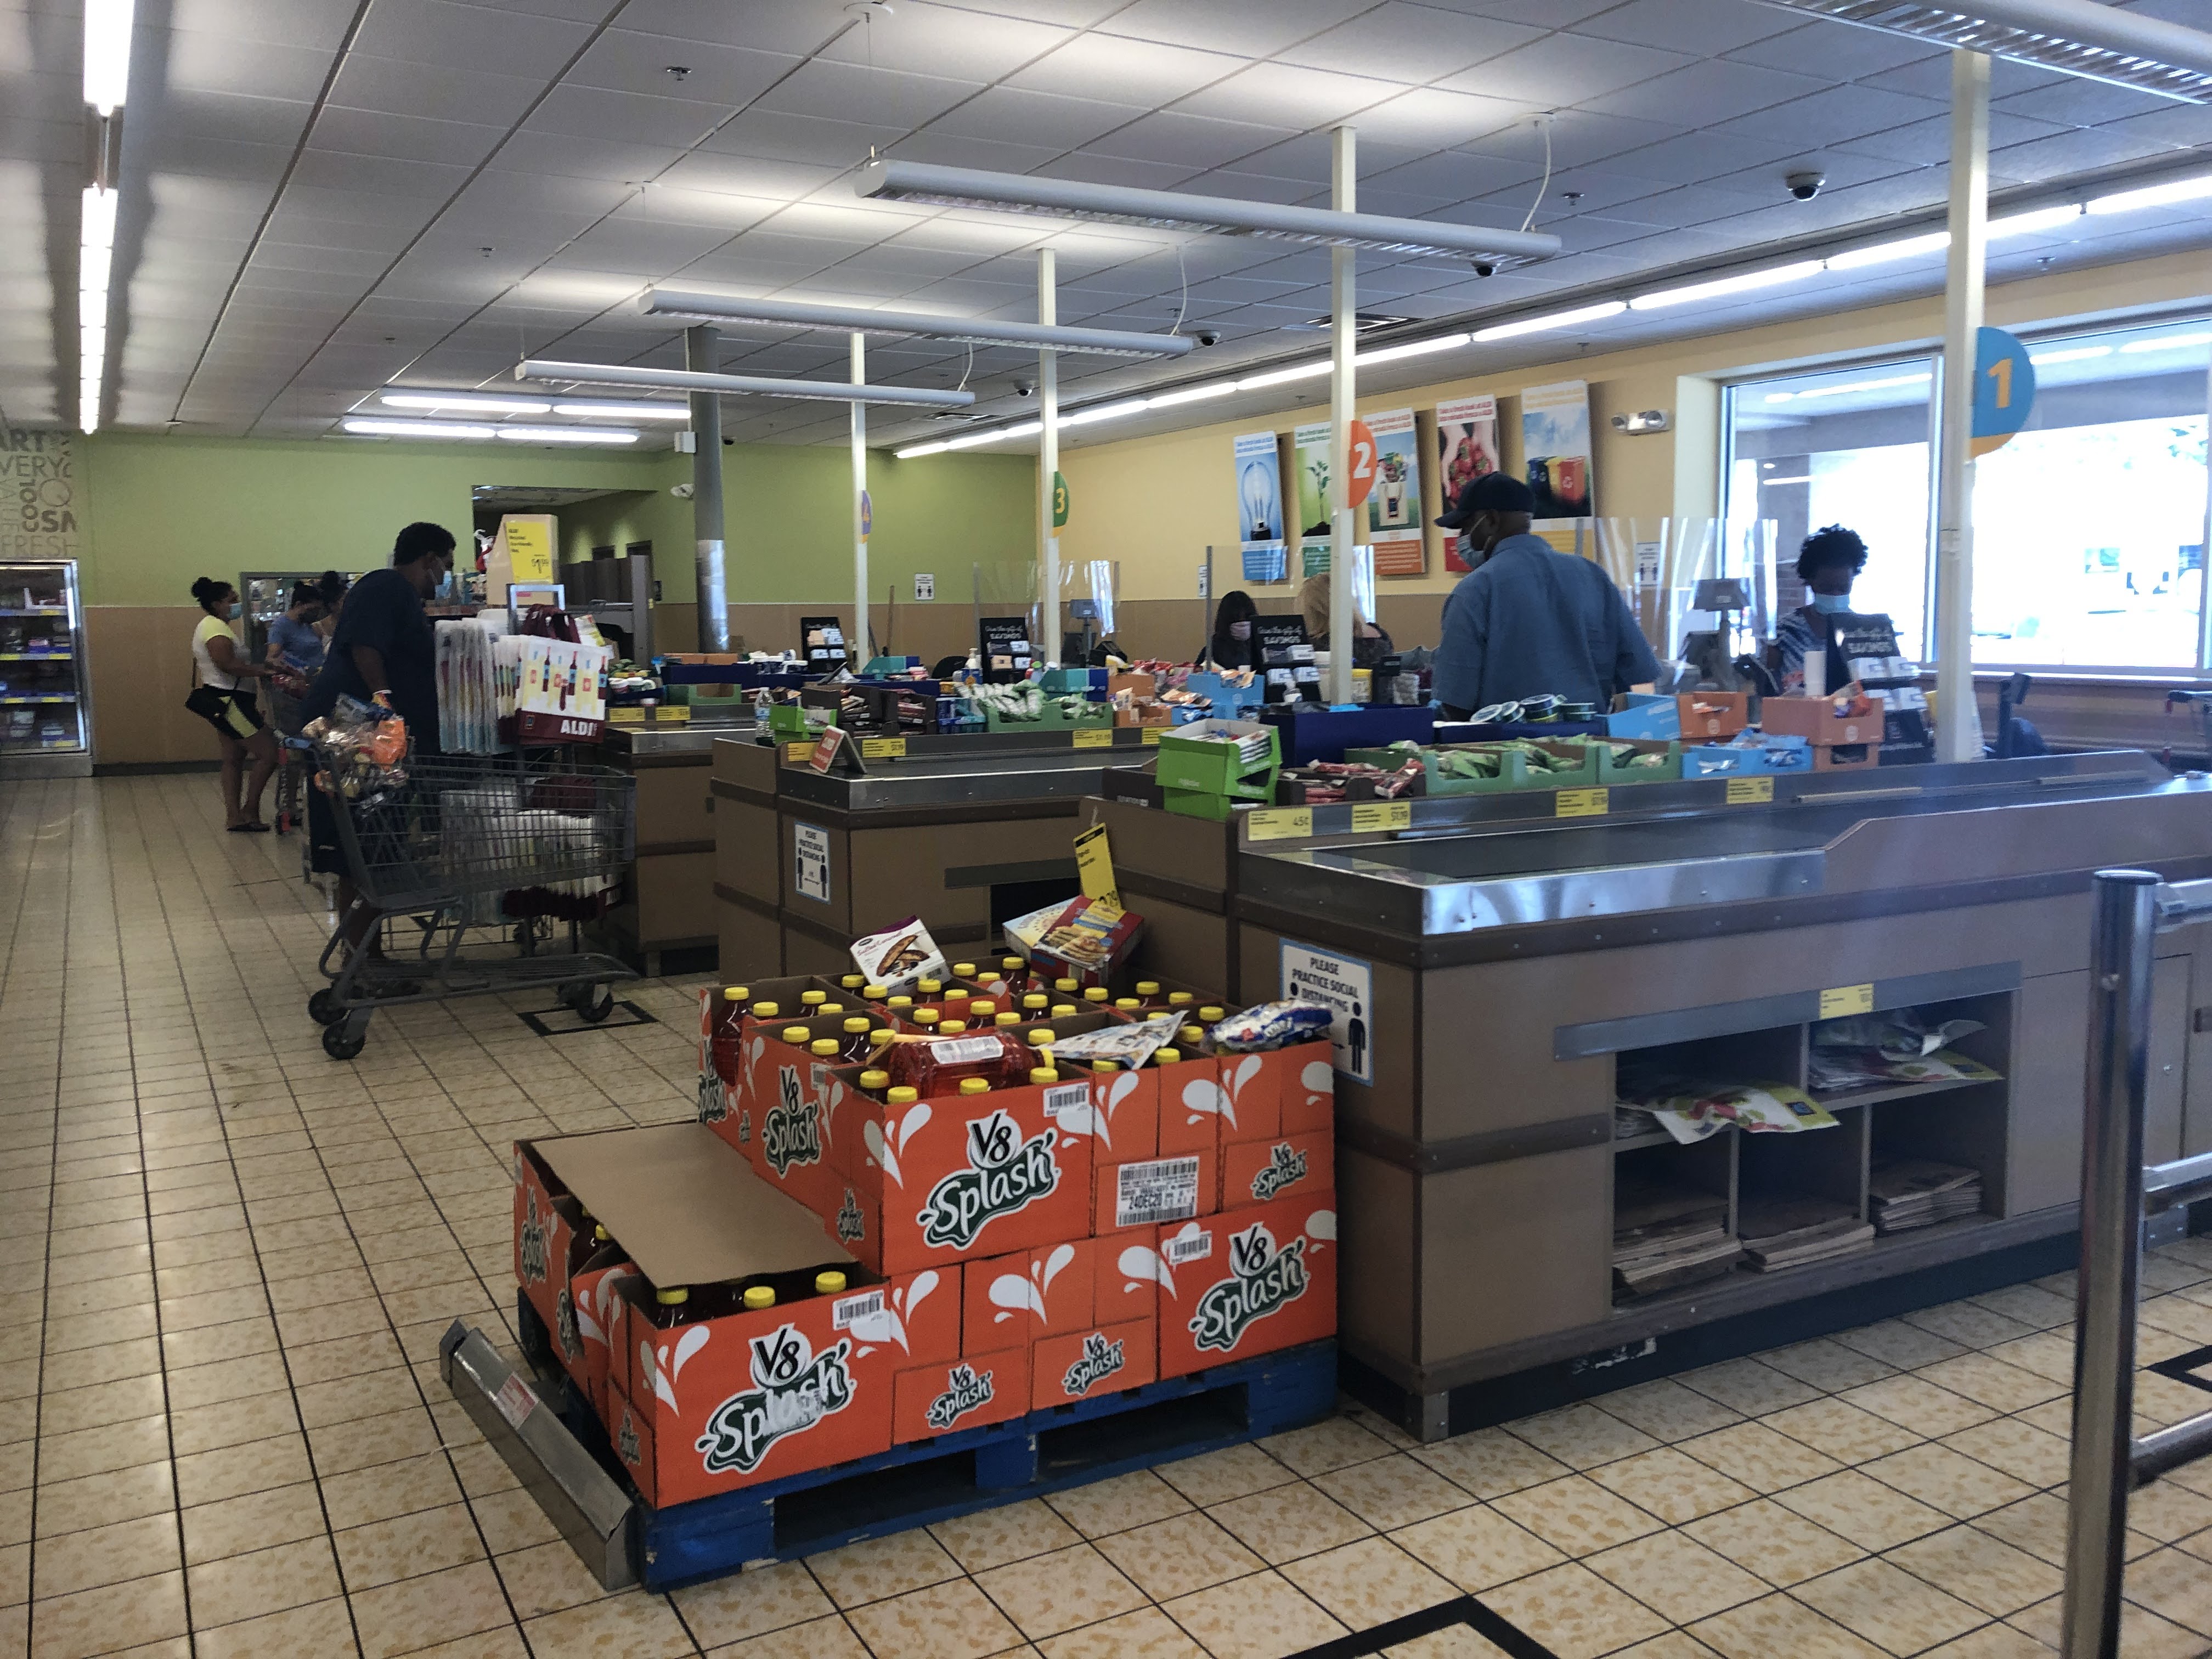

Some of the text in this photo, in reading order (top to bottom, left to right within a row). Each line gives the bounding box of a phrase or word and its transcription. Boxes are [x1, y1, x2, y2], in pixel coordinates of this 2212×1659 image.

[1988, 358, 2013, 409] 1
[1353, 442, 1372, 479] 2
[1056, 488, 1065, 514] 3
[561, 719, 594, 736] ALDI
[1291, 968, 1359, 999] PRACTICE SOCIAL
[1310, 957, 1339, 975] PLEASE
[781, 1068, 799, 1114] V8
[768, 1109, 818, 1167] Splash
[972, 1113, 1012, 1164] V8
[933, 1144, 1052, 1238] Splash
[1234, 1226, 1267, 1270] V8
[1204, 1254, 1303, 1340] Splash
[755, 1328, 800, 1380] V8
[952, 1365, 971, 1387] V8
[1068, 1348, 1121, 1389] Splash
[933, 1379, 989, 1423] Splash
